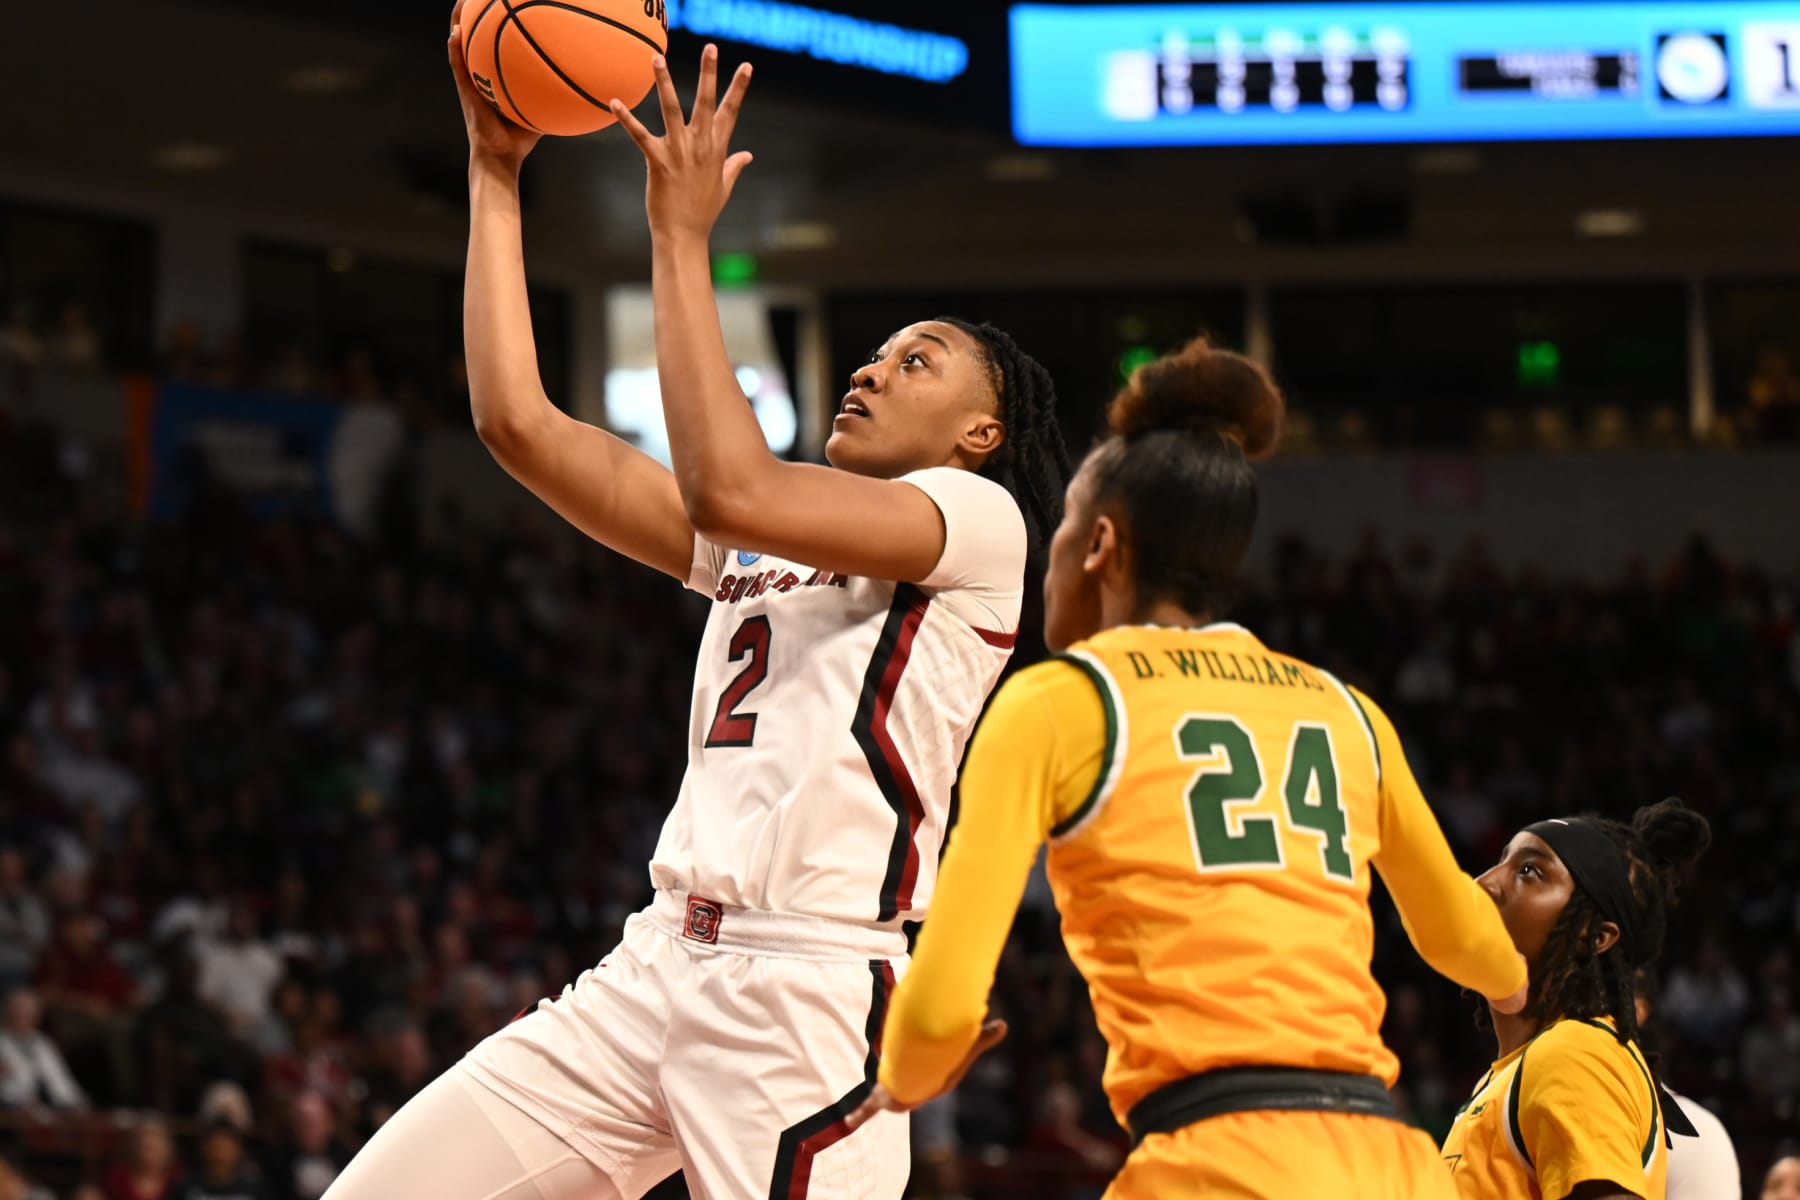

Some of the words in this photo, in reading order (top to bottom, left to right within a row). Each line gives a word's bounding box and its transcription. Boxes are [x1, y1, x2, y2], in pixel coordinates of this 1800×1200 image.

[704, 614, 772, 749] 2
[1125, 651, 1165, 679] D.
[1164, 648, 1325, 693] WILLIAMS
[1172, 712, 1356, 885] 24
